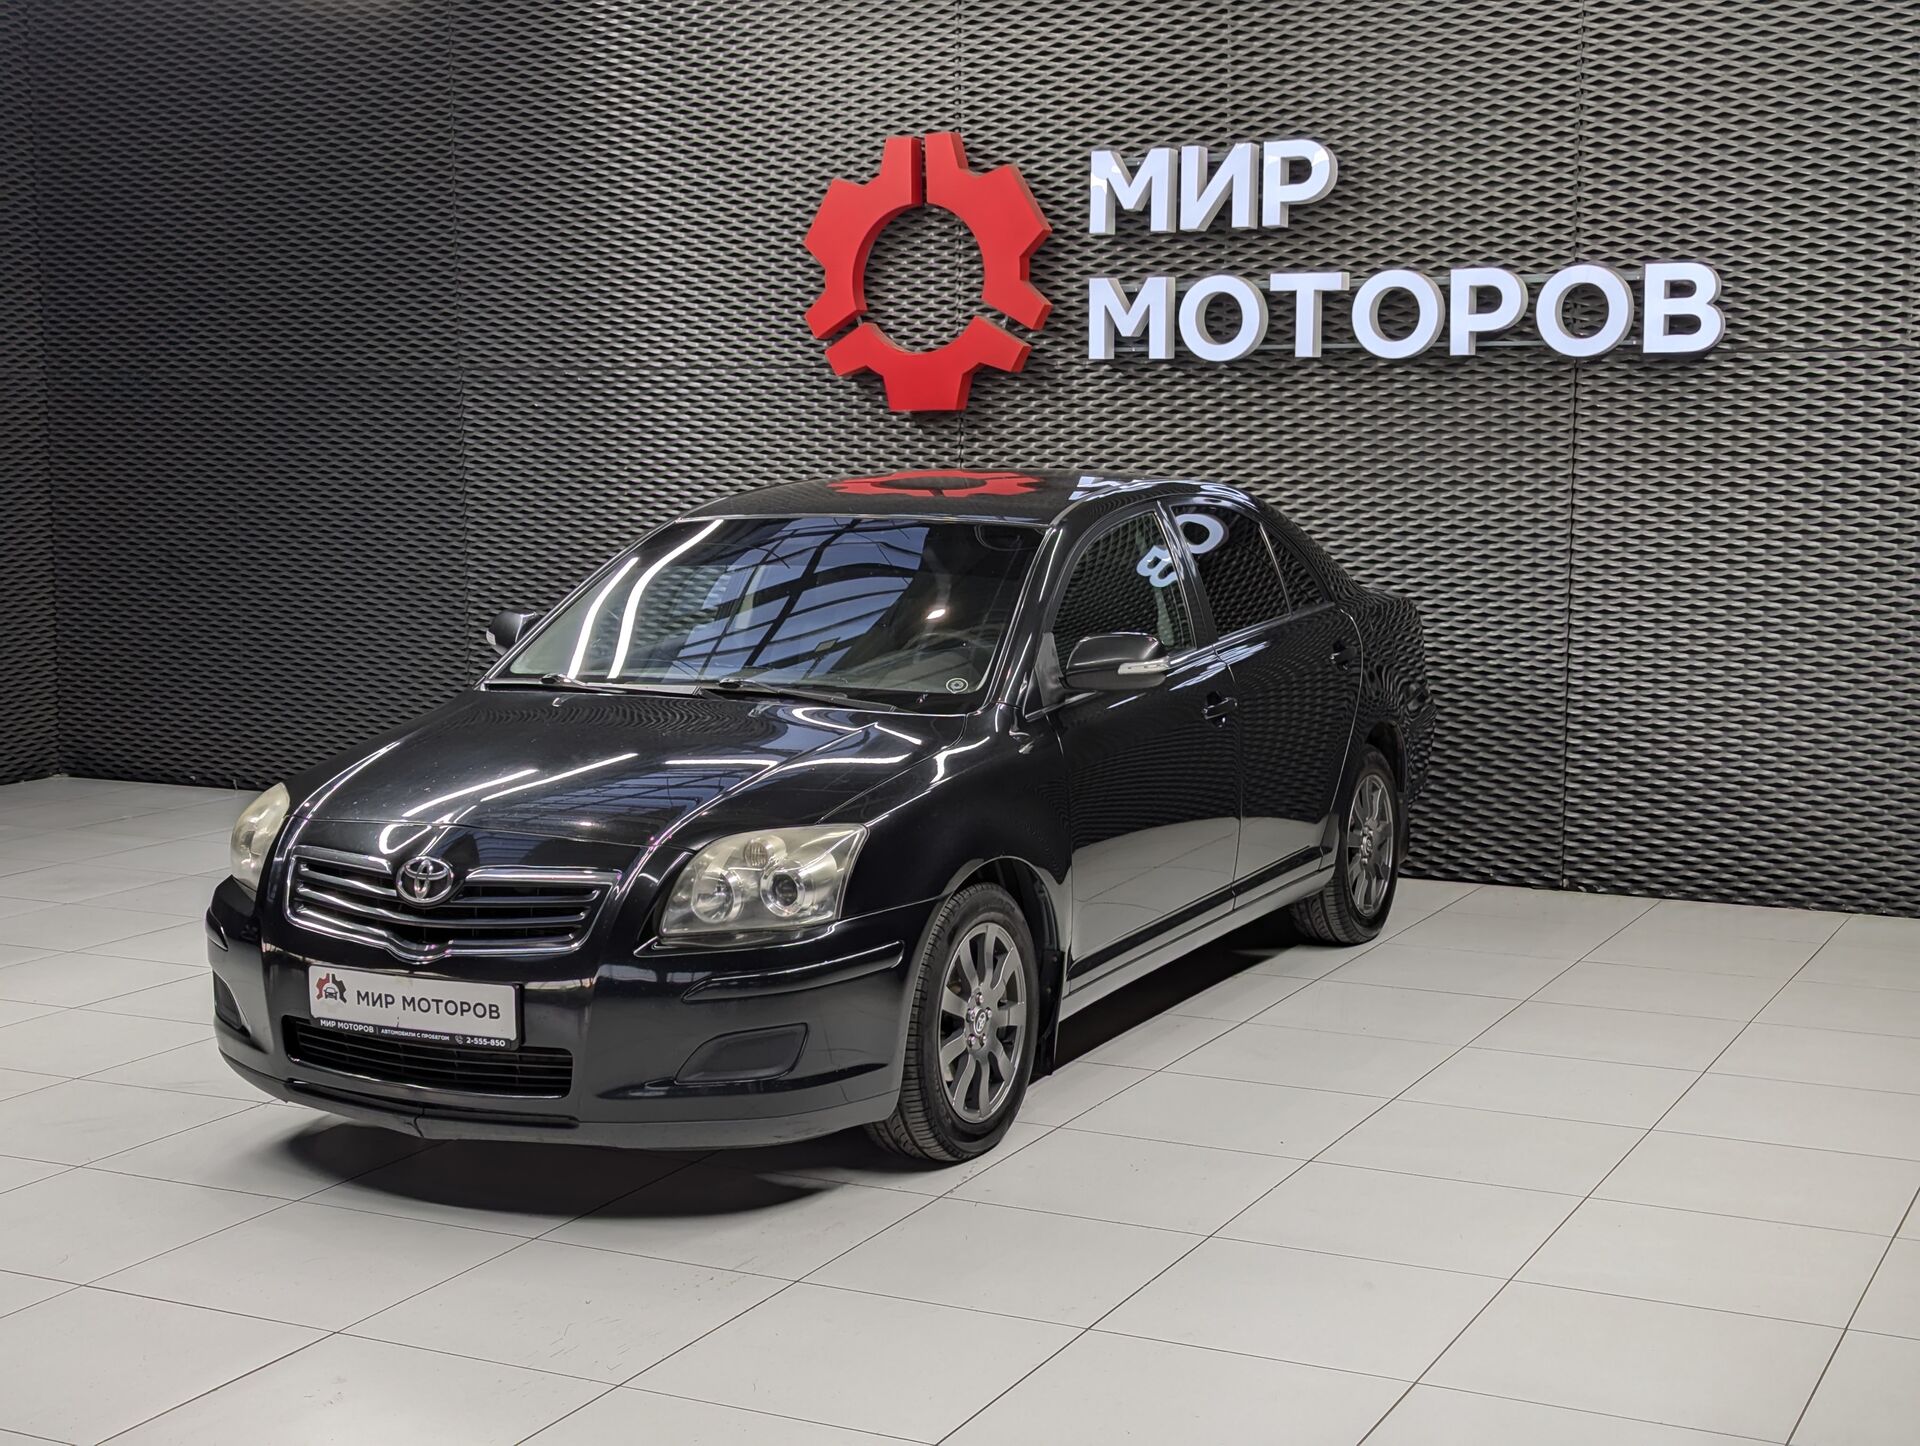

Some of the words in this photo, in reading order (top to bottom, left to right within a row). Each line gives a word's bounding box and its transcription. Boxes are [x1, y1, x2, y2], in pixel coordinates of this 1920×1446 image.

[1089, 138, 1339, 235] МИР
[1087, 261, 1726, 363] МОТОРОВ
[356, 990, 395, 1009] МИР
[402, 995, 500, 1019] МОТОРОВ
[320, 1019, 337, 1029] МИР
[337, 1020, 375, 1035] МОТОРОВ
[466, 1036, 506, 1047] 2-555-850
